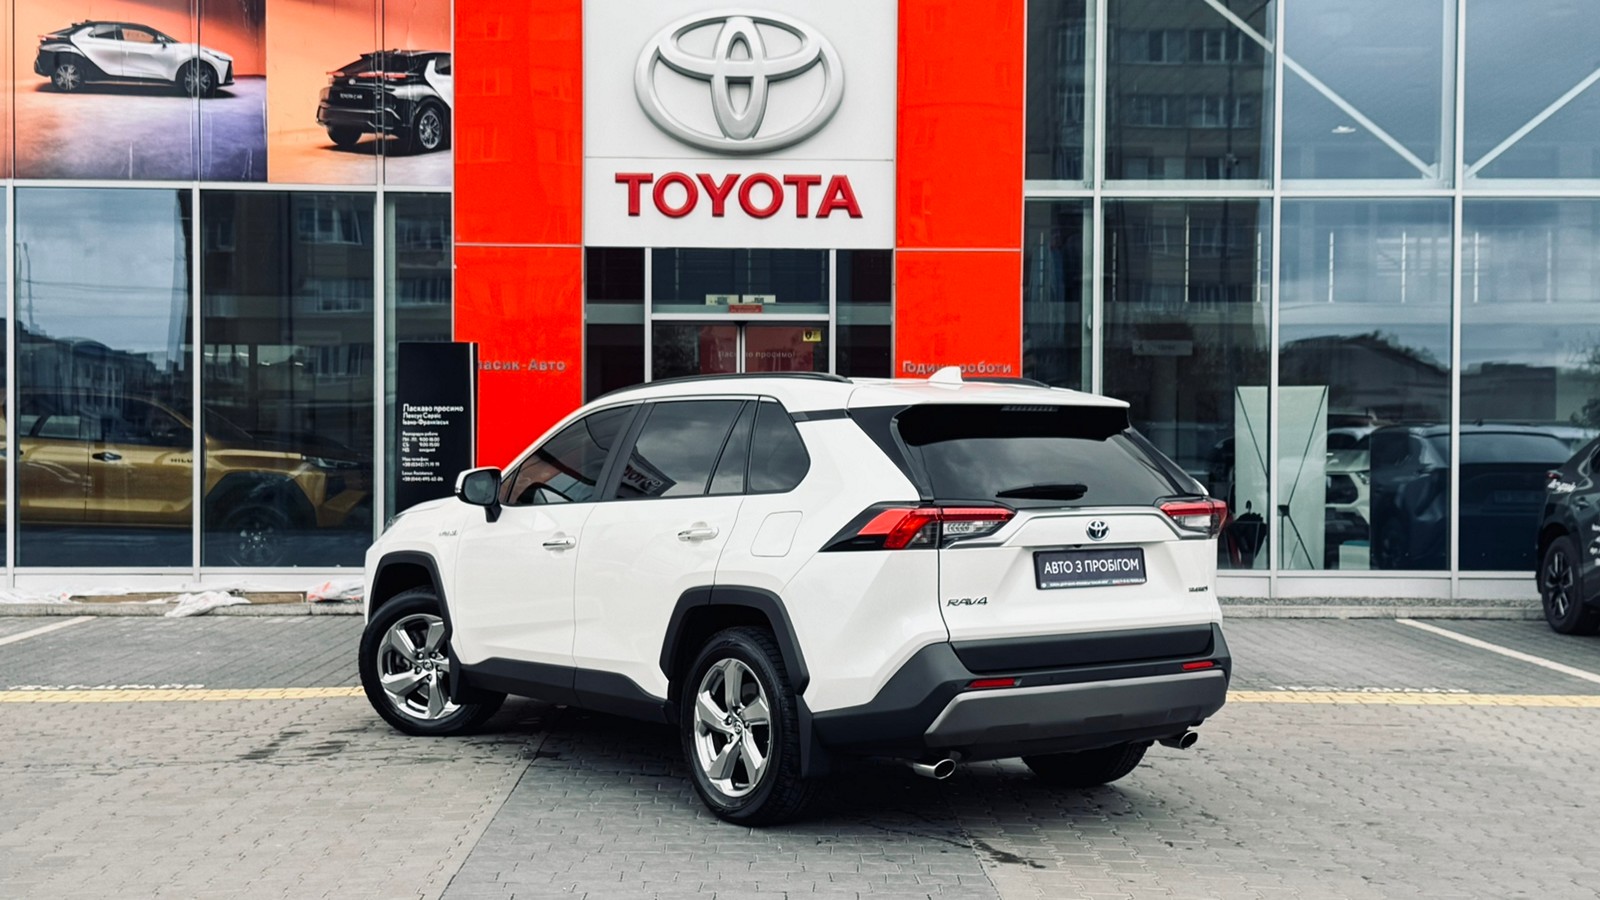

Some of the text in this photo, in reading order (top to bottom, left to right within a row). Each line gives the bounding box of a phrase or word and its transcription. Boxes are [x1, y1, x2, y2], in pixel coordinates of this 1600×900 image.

[615, 172, 863, 219] TOYOTA
[902, 361, 946, 374] Годи
[403, 403, 433, 412] Ласкаво
[1044, 561, 1073, 574] АВТО
[1084, 558, 1139, 573] ПРОБІГОМ
[946, 596, 988, 607] RAV4
